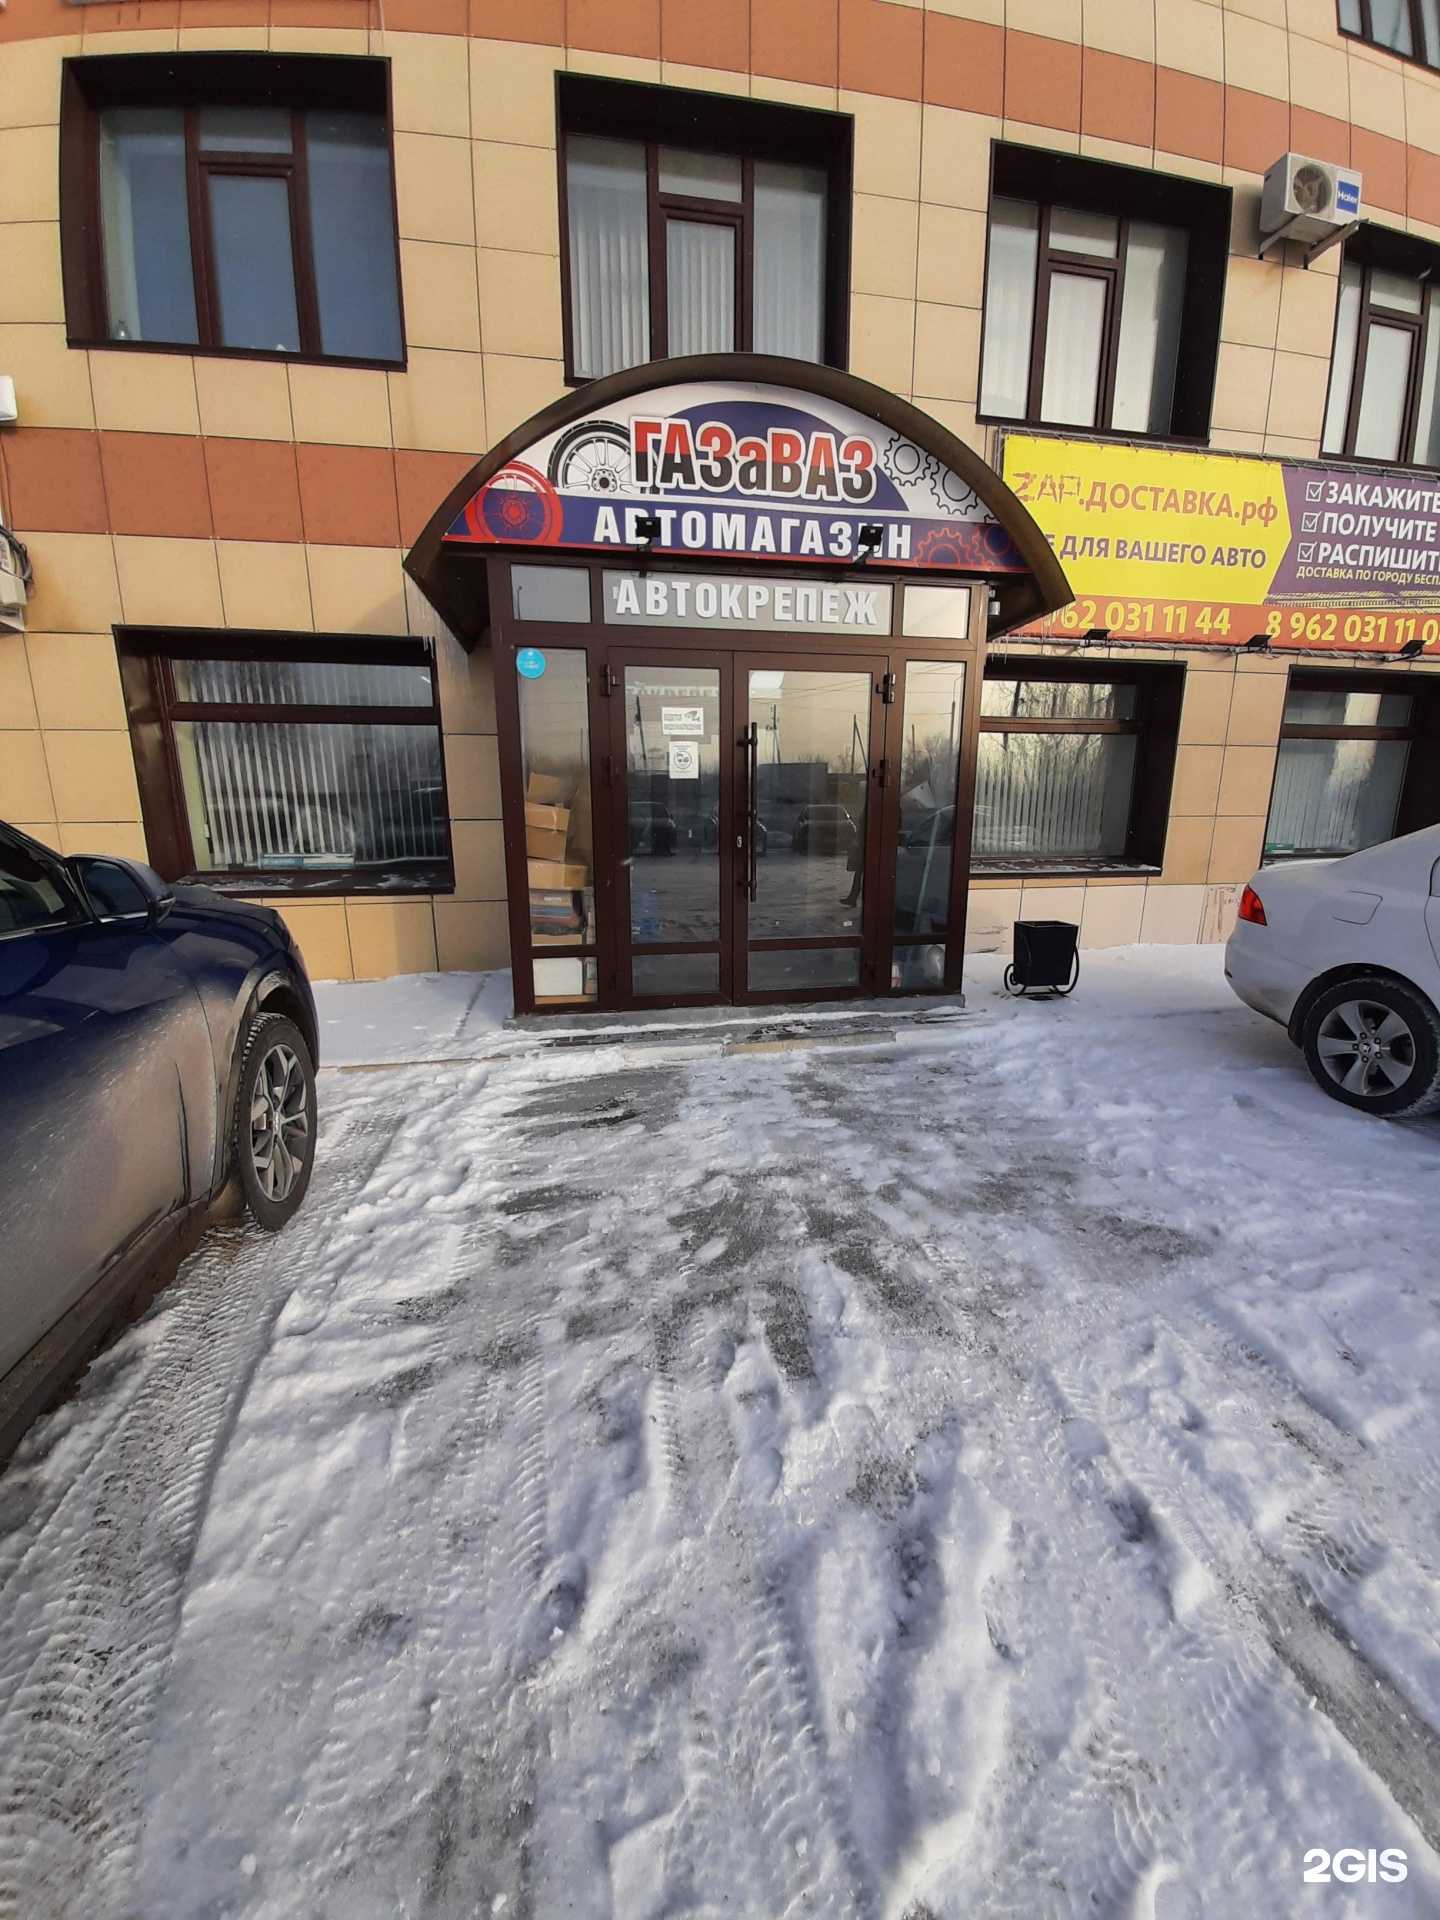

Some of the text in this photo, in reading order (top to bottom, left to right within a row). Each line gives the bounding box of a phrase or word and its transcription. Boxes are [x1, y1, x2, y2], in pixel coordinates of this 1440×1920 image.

[1337, 191, 1358, 204] Haier
[632, 417, 876, 502] ГАЗаВАЗ
[1326, 481, 1440, 514] ЗАКАЖИТЕ
[1322, 512, 1437, 542] ПОЛУЧИТЕ
[1059, 535, 1109, 560] ДЛЯ
[1115, 539, 1206, 564] ВАШЕГО
[1211, 546, 1266, 568] АВТО
[1318, 542, 1440, 571] РАСПИШИТ
[1296, 566, 1353, 580] ДОСТАВКА
[1355, 569, 1371, 580] ПО
[1373, 571, 1413, 585] ГОРОДУ
[615, 578, 877, 625] АВТОКРЕПЕЖ
[1105, 601, 1154, 632] 031
[1163, 605, 1188, 633] 11
[1194, 607, 1231, 635] 44
[1265, 610, 1282, 639] 8
[1290, 612, 1338, 641] 962
[1344, 614, 1388, 643] 031
[1394, 618, 1416, 644] 11
